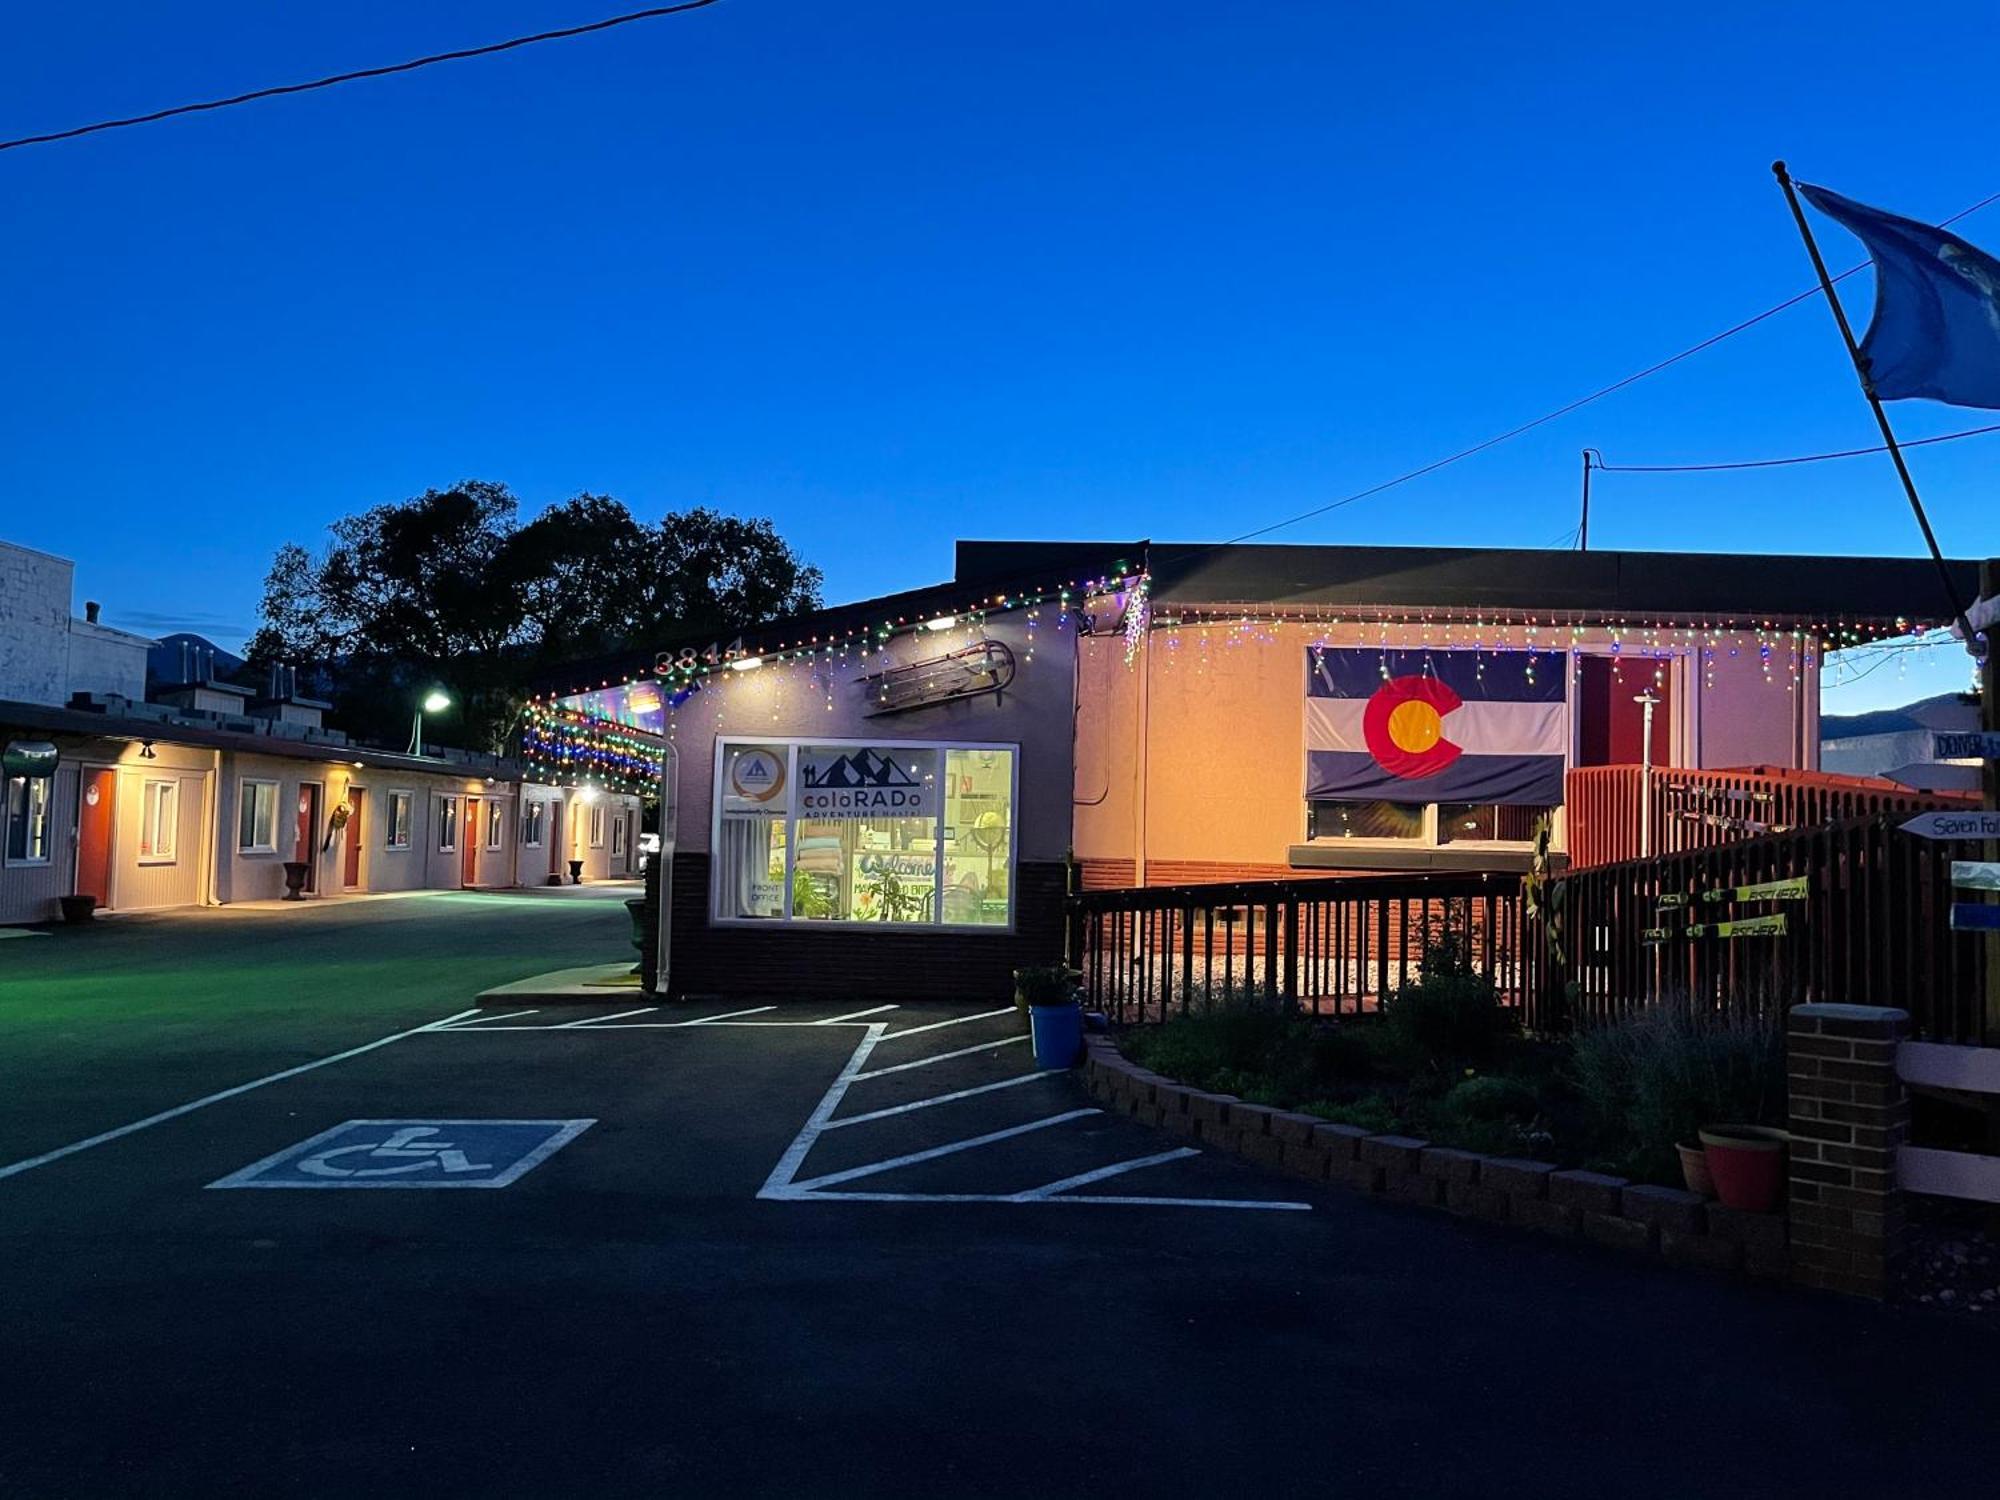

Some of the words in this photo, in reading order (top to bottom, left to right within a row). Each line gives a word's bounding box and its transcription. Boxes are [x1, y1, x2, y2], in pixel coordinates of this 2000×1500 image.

[653, 635, 744, 675] 3844
[1937, 735, 1981, 756] DENVER
[803, 790, 921, 808] coloRADo
[1932, 817, 1977, 835] Seven
[860, 853, 936, 876] Welcome
